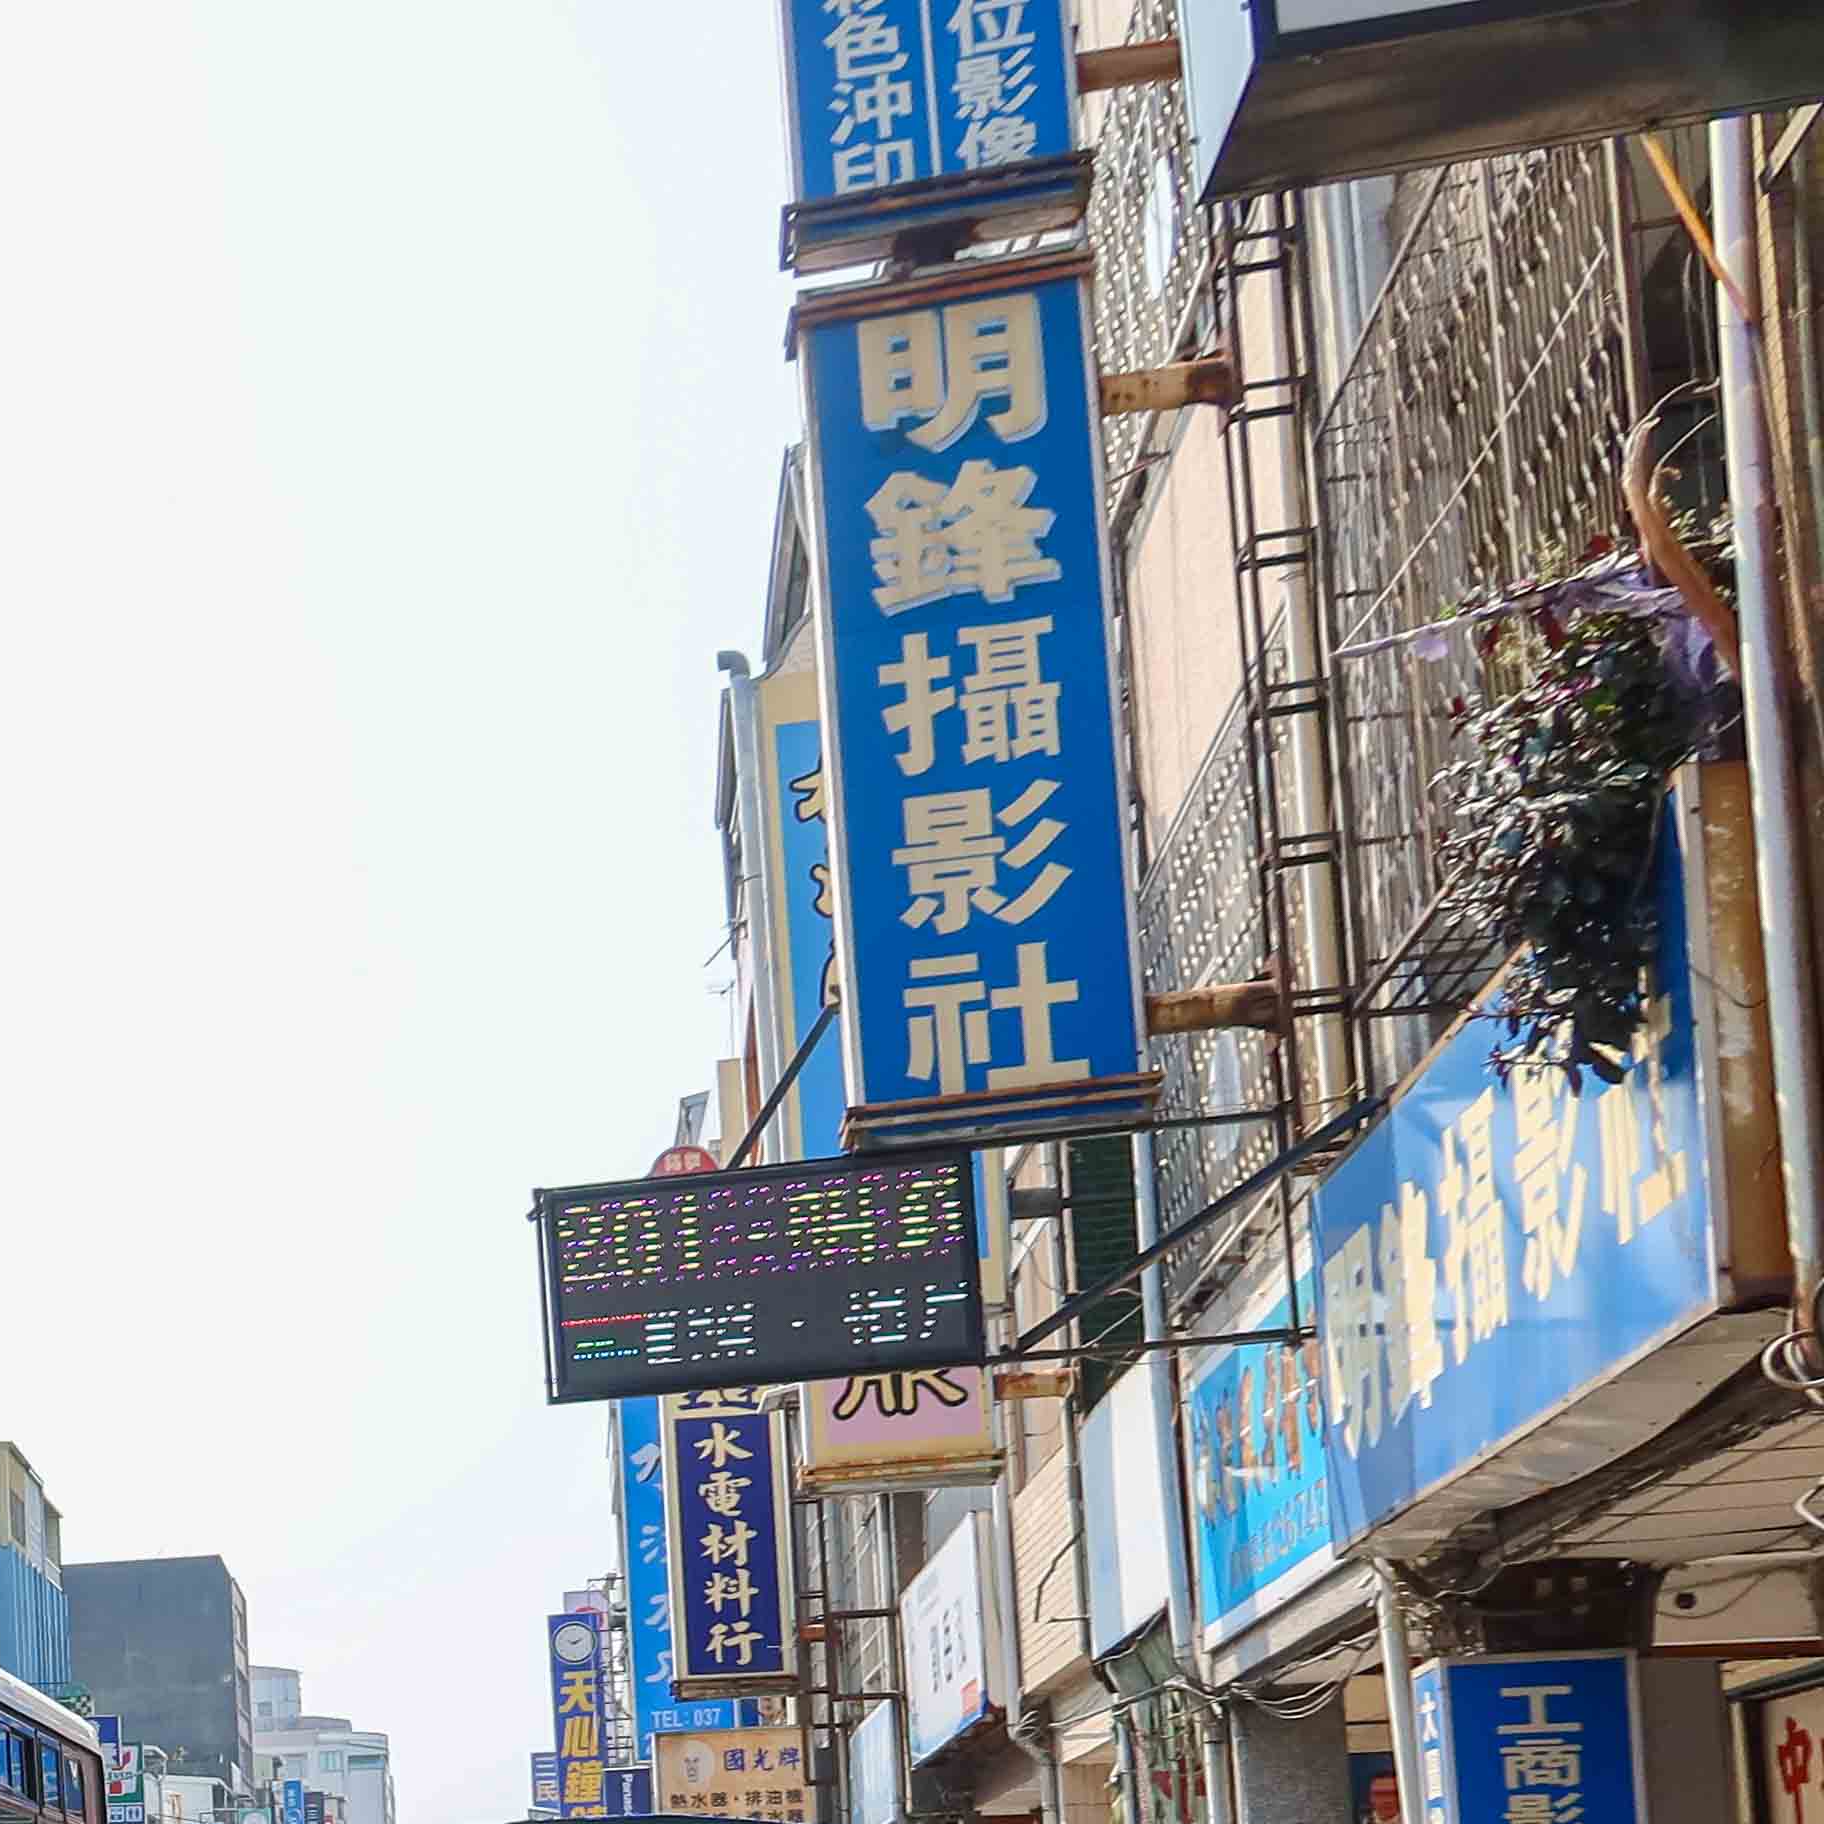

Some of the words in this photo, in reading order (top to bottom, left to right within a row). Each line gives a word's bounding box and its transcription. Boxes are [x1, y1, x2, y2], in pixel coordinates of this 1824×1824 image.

[820, 0, 918, 196] 色沖印
[856, 292, 1092, 1092] 明鋒攝影社
[692, 1422, 764, 1668] 水電材料行
[693, 1706, 721, 1727] 037
[723, 1746, 802, 1773] 國光牌
